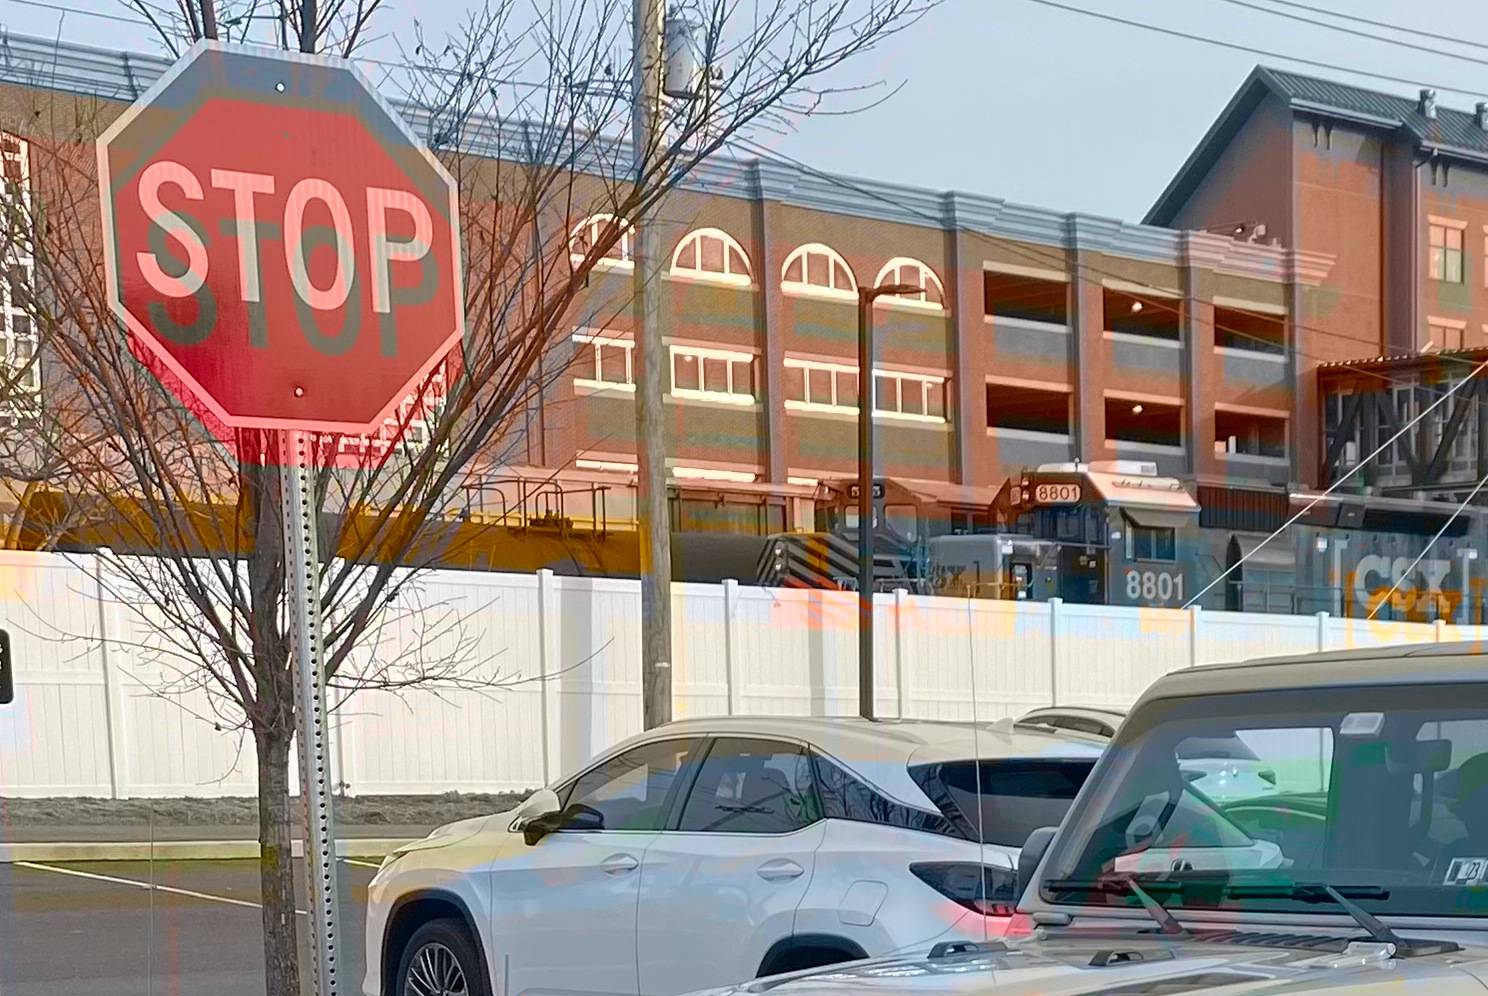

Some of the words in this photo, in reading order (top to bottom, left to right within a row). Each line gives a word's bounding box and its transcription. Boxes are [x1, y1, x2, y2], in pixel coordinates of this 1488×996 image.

[136, 160, 434, 314] STOP
[1038, 486, 1080, 500] 8801
[1125, 570, 1185, 601] 8801
[1354, 554, 1451, 613] CSX
